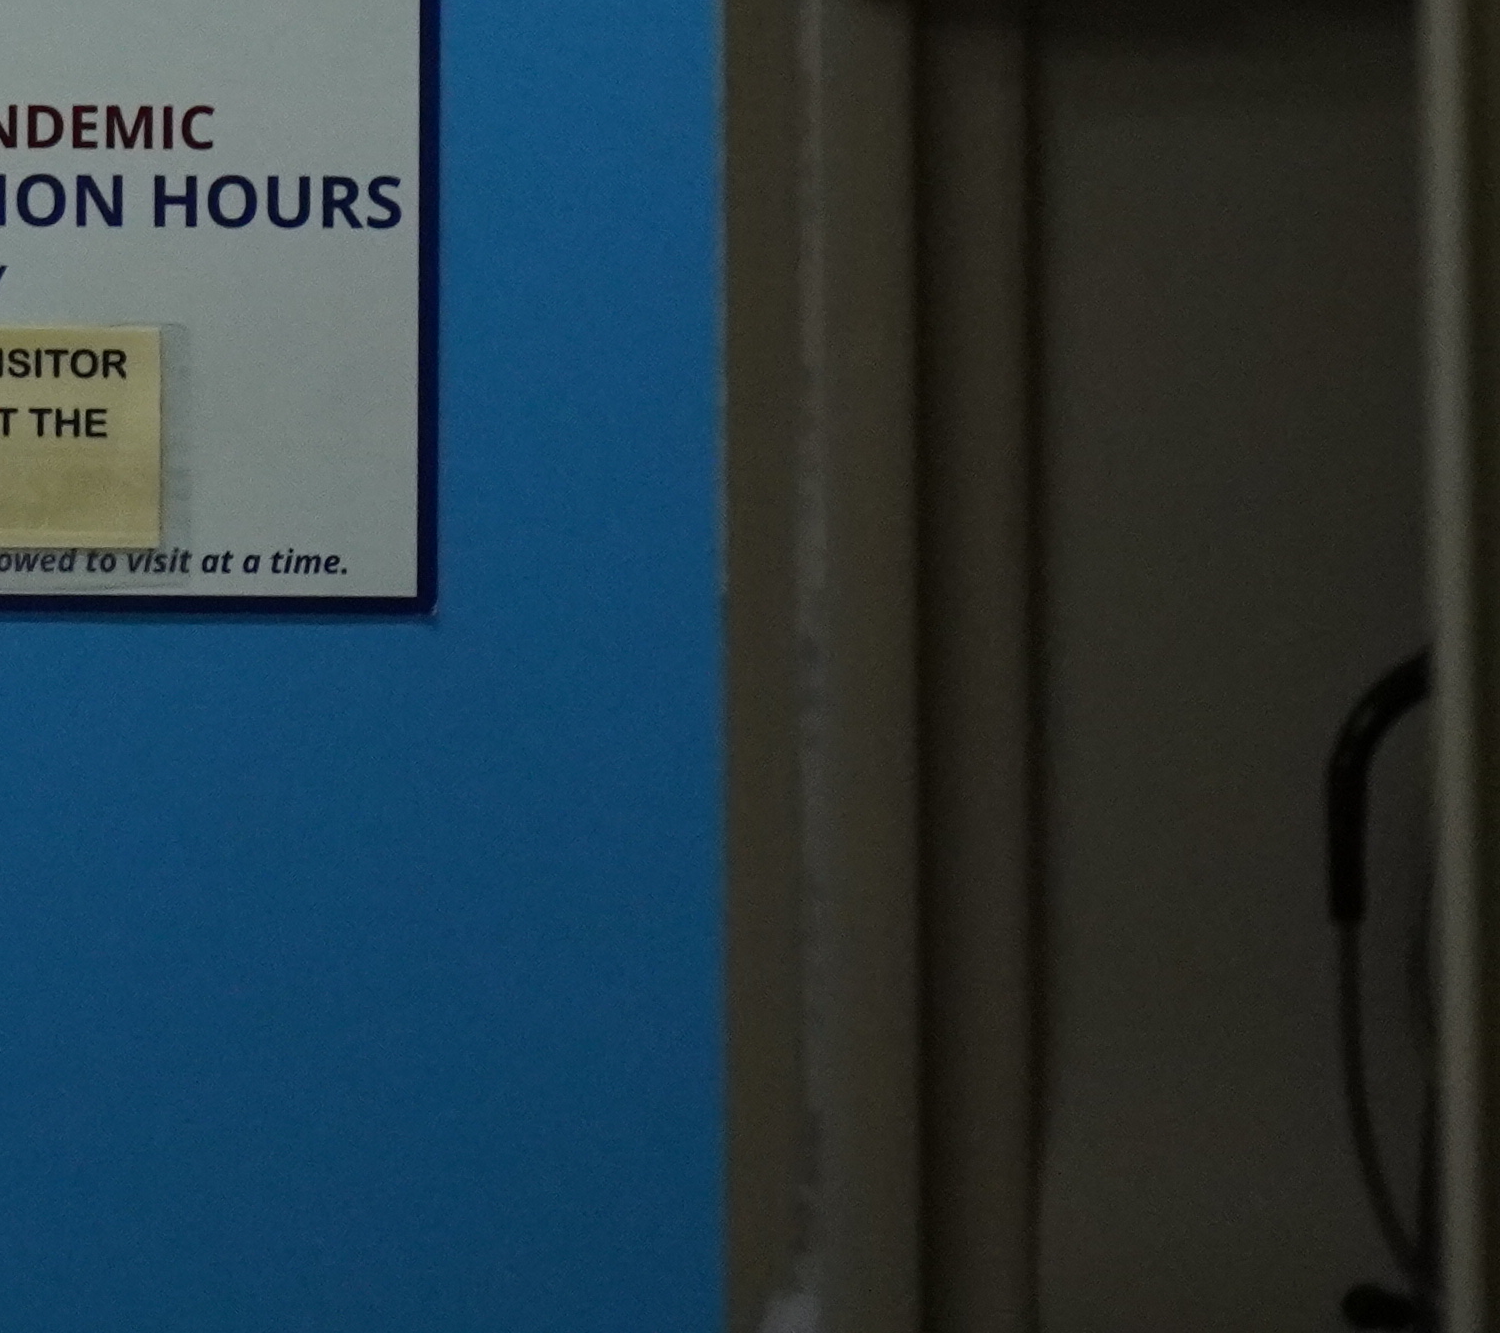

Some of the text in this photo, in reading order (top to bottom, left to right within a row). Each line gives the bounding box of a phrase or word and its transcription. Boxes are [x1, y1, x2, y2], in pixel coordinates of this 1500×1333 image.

[154, 175, 401, 229] HOURS
[29, 408, 107, 438] THE
[85, 549, 117, 574] to
[126, 548, 192, 574] visit
[201, 552, 234, 574] at
[242, 554, 261, 574] a
[270, 549, 348, 575] time.
